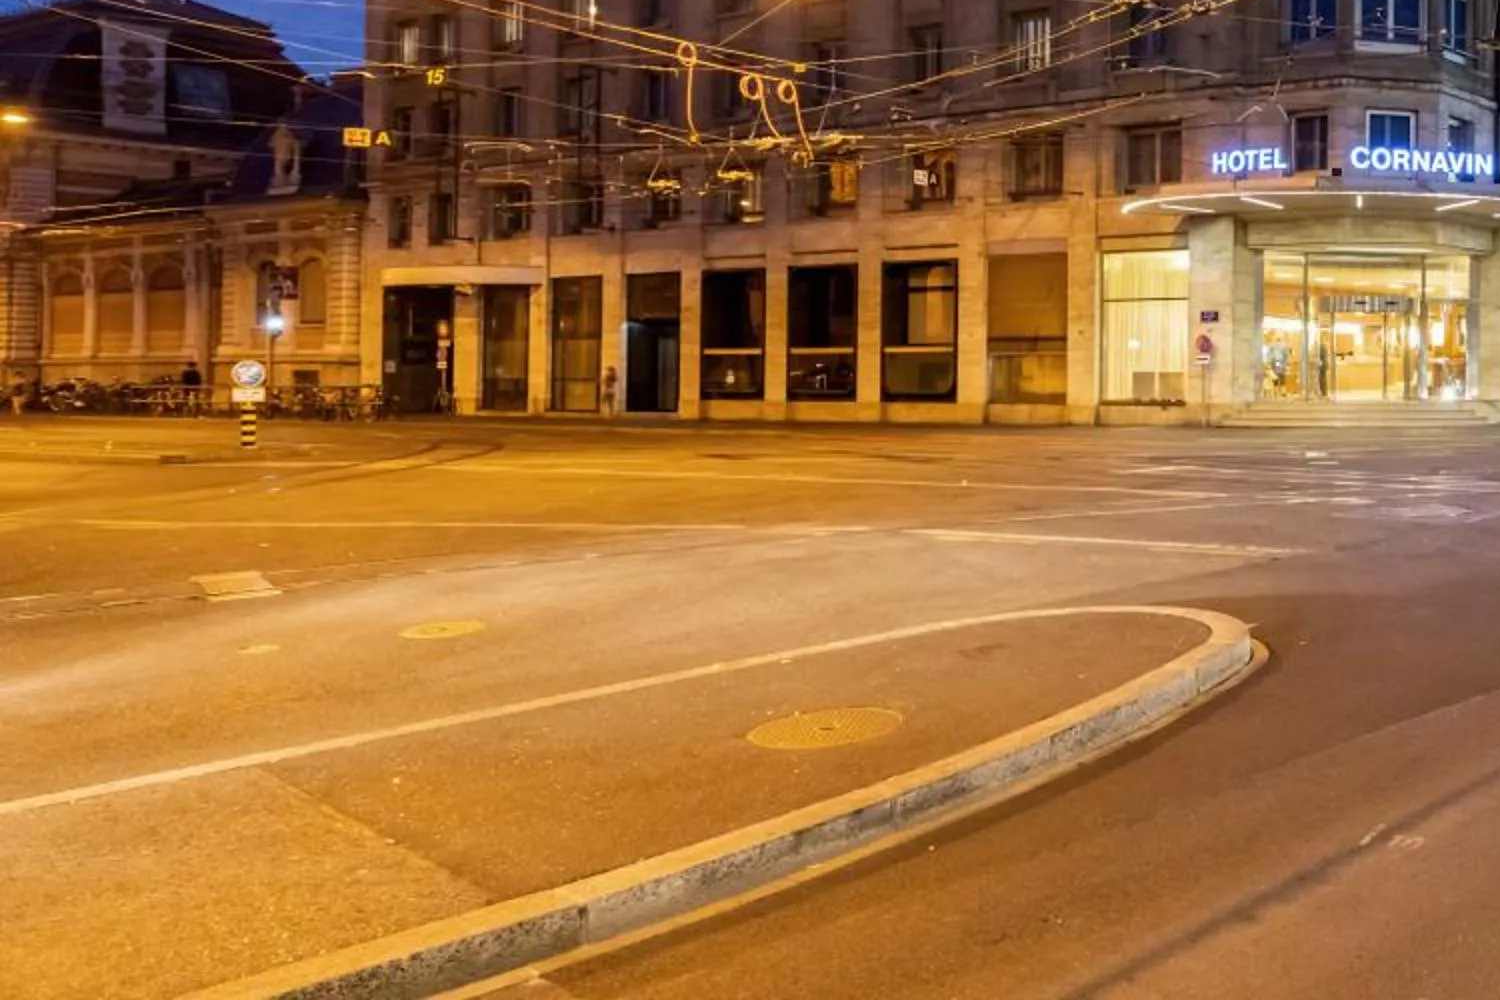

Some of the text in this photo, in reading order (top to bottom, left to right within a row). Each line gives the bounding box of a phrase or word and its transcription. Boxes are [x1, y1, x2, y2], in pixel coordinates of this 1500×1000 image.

[426, 68, 445, 85] 15
[375, 132, 392, 146] A
[1211, 145, 1495, 176] HOTEL CORNAVIN
